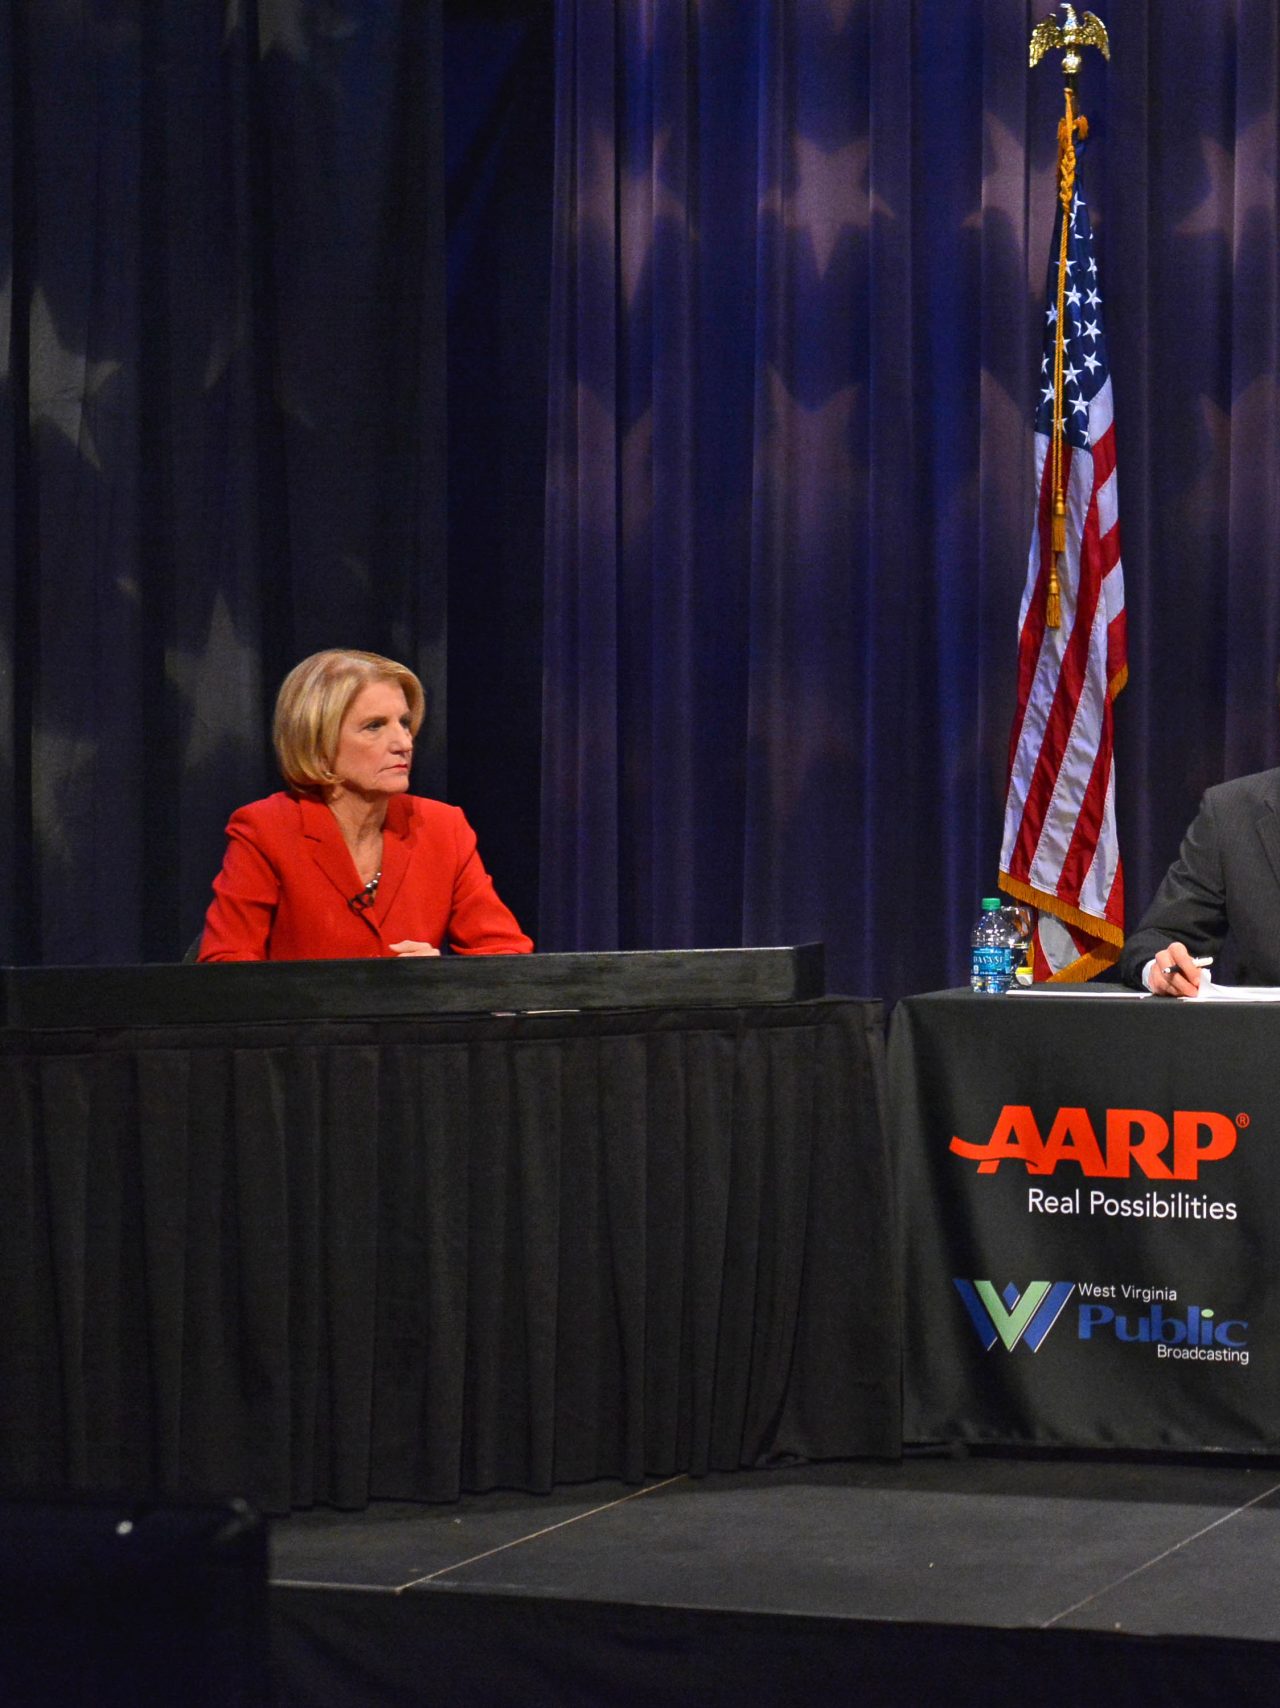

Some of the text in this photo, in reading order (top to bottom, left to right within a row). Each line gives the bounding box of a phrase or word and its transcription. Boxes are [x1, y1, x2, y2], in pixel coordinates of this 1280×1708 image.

[949, 1105, 1238, 1180] AARP
[1028, 1188, 1238, 1220] Real Possibilities
[1078, 1283, 1178, 1303] West Virginia
[1078, 1304, 1249, 1347] Public
[1157, 1344, 1250, 1366] Broadcasting
